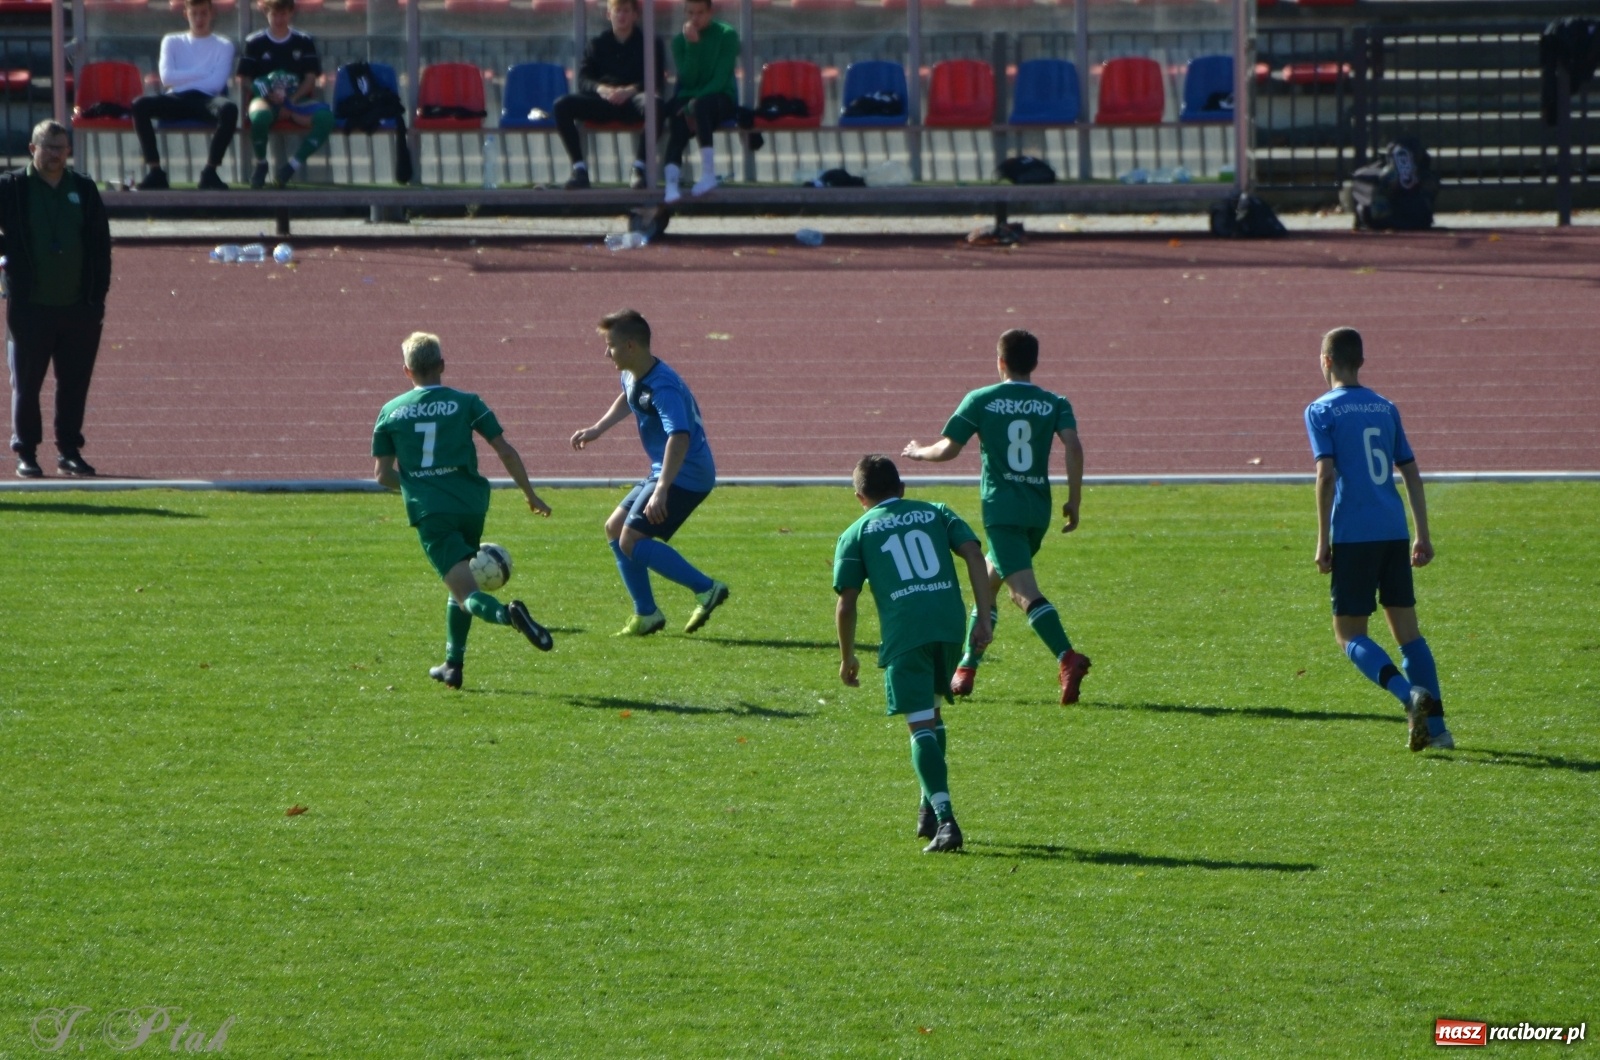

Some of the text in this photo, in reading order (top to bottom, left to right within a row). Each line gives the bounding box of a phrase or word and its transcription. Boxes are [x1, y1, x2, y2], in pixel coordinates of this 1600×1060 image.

[397, 401, 459, 420] REKORD
[993, 398, 1053, 416] REKORD
[414, 422, 437, 468] 7
[1007, 419, 1033, 472] 8
[1362, 427, 1389, 486] 6
[872, 510, 936, 533] REKORD
[880, 529, 941, 581] 10
